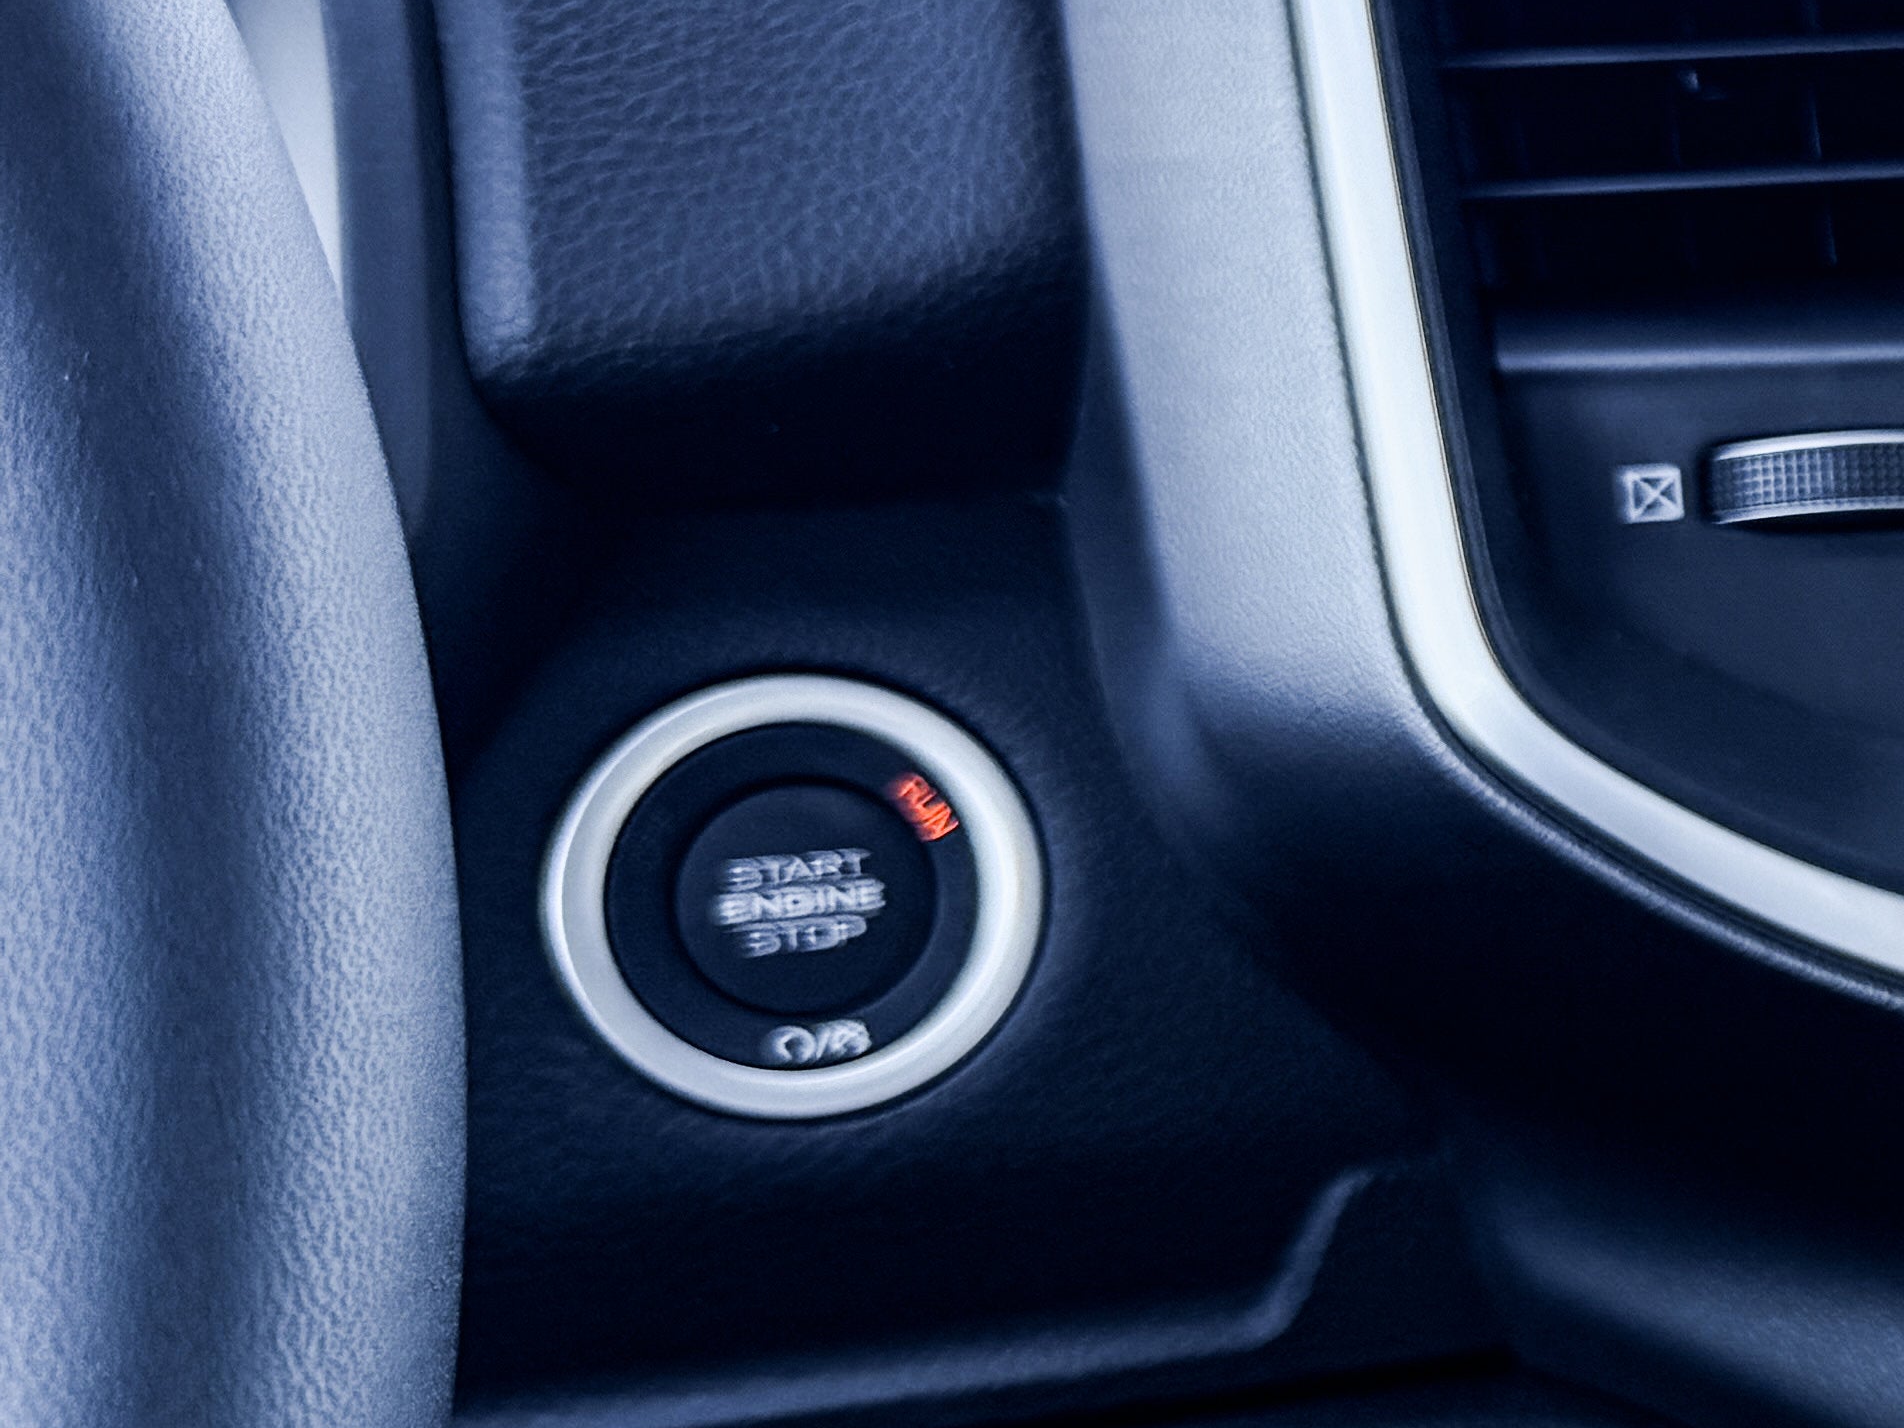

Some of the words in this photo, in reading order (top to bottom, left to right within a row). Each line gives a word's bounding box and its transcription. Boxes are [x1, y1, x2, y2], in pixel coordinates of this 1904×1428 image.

[722, 847, 873, 889] START
[715, 877, 886, 926] ENGINE
[730, 914, 867, 958] STOP
